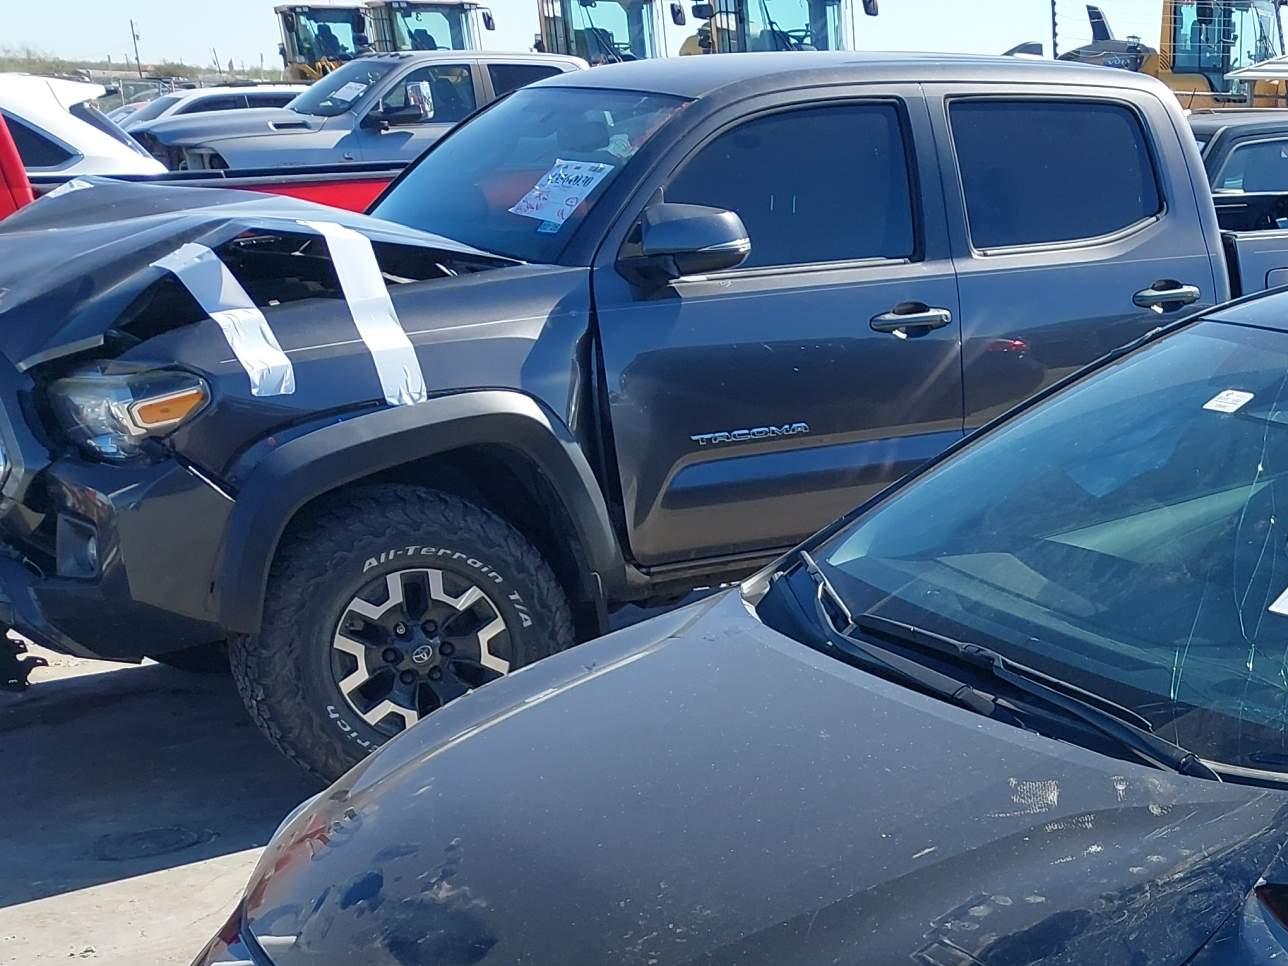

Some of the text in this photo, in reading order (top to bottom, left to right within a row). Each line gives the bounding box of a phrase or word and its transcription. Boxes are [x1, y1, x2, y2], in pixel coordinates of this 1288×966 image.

[690, 422, 810, 445] TACOMA
[363, 545, 532, 628] All-Terrain T/A
